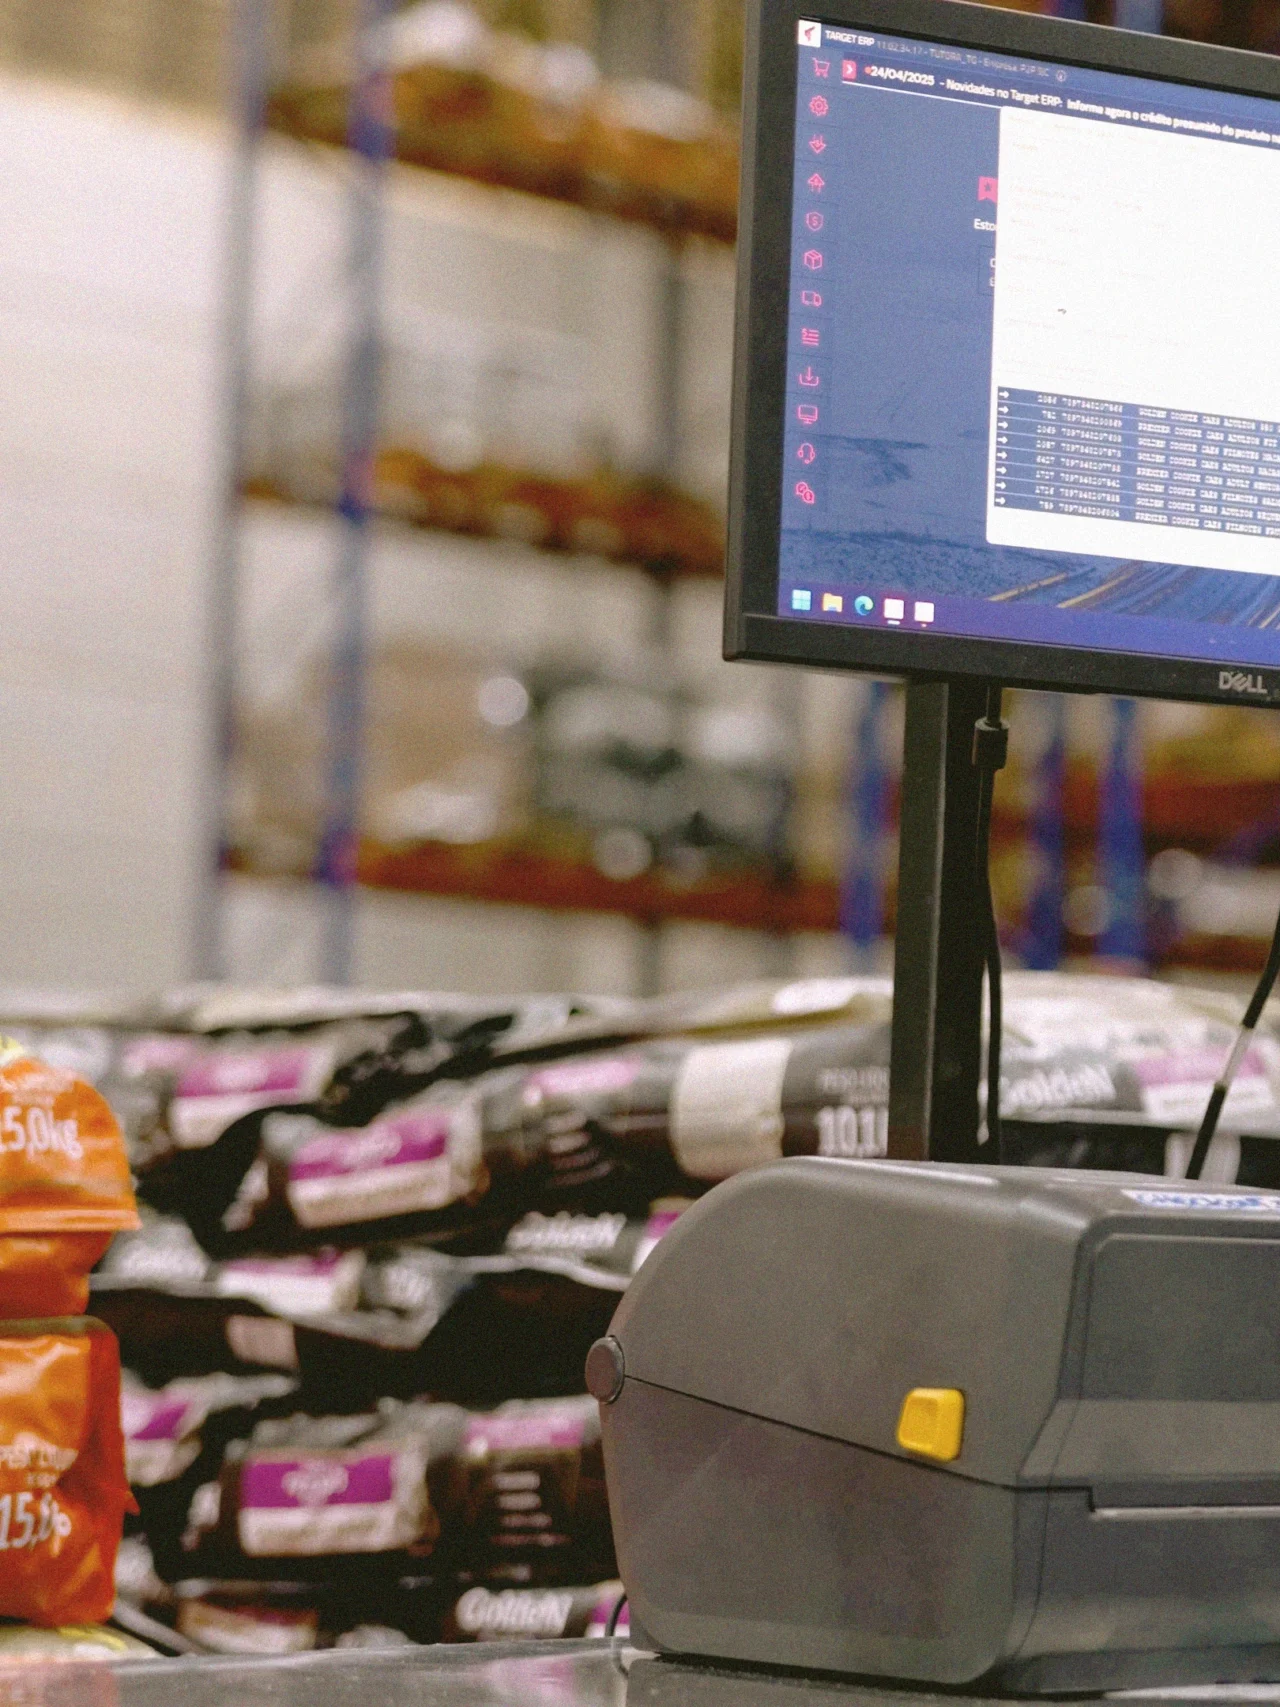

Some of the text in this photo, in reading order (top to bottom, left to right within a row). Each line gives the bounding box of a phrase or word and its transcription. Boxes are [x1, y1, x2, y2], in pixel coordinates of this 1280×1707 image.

[825, 30, 857, 44] TARGET
[857, 34, 874, 46] ERP
[871, 66, 934, 86] 24/04/2025
[946, 79, 995, 97] Novidades
[996, 90, 1009, 99] no
[1011, 89, 1040, 105] Target
[1041, 94, 1062, 107] ERP:
[1219, 671, 1268, 694] DELL
